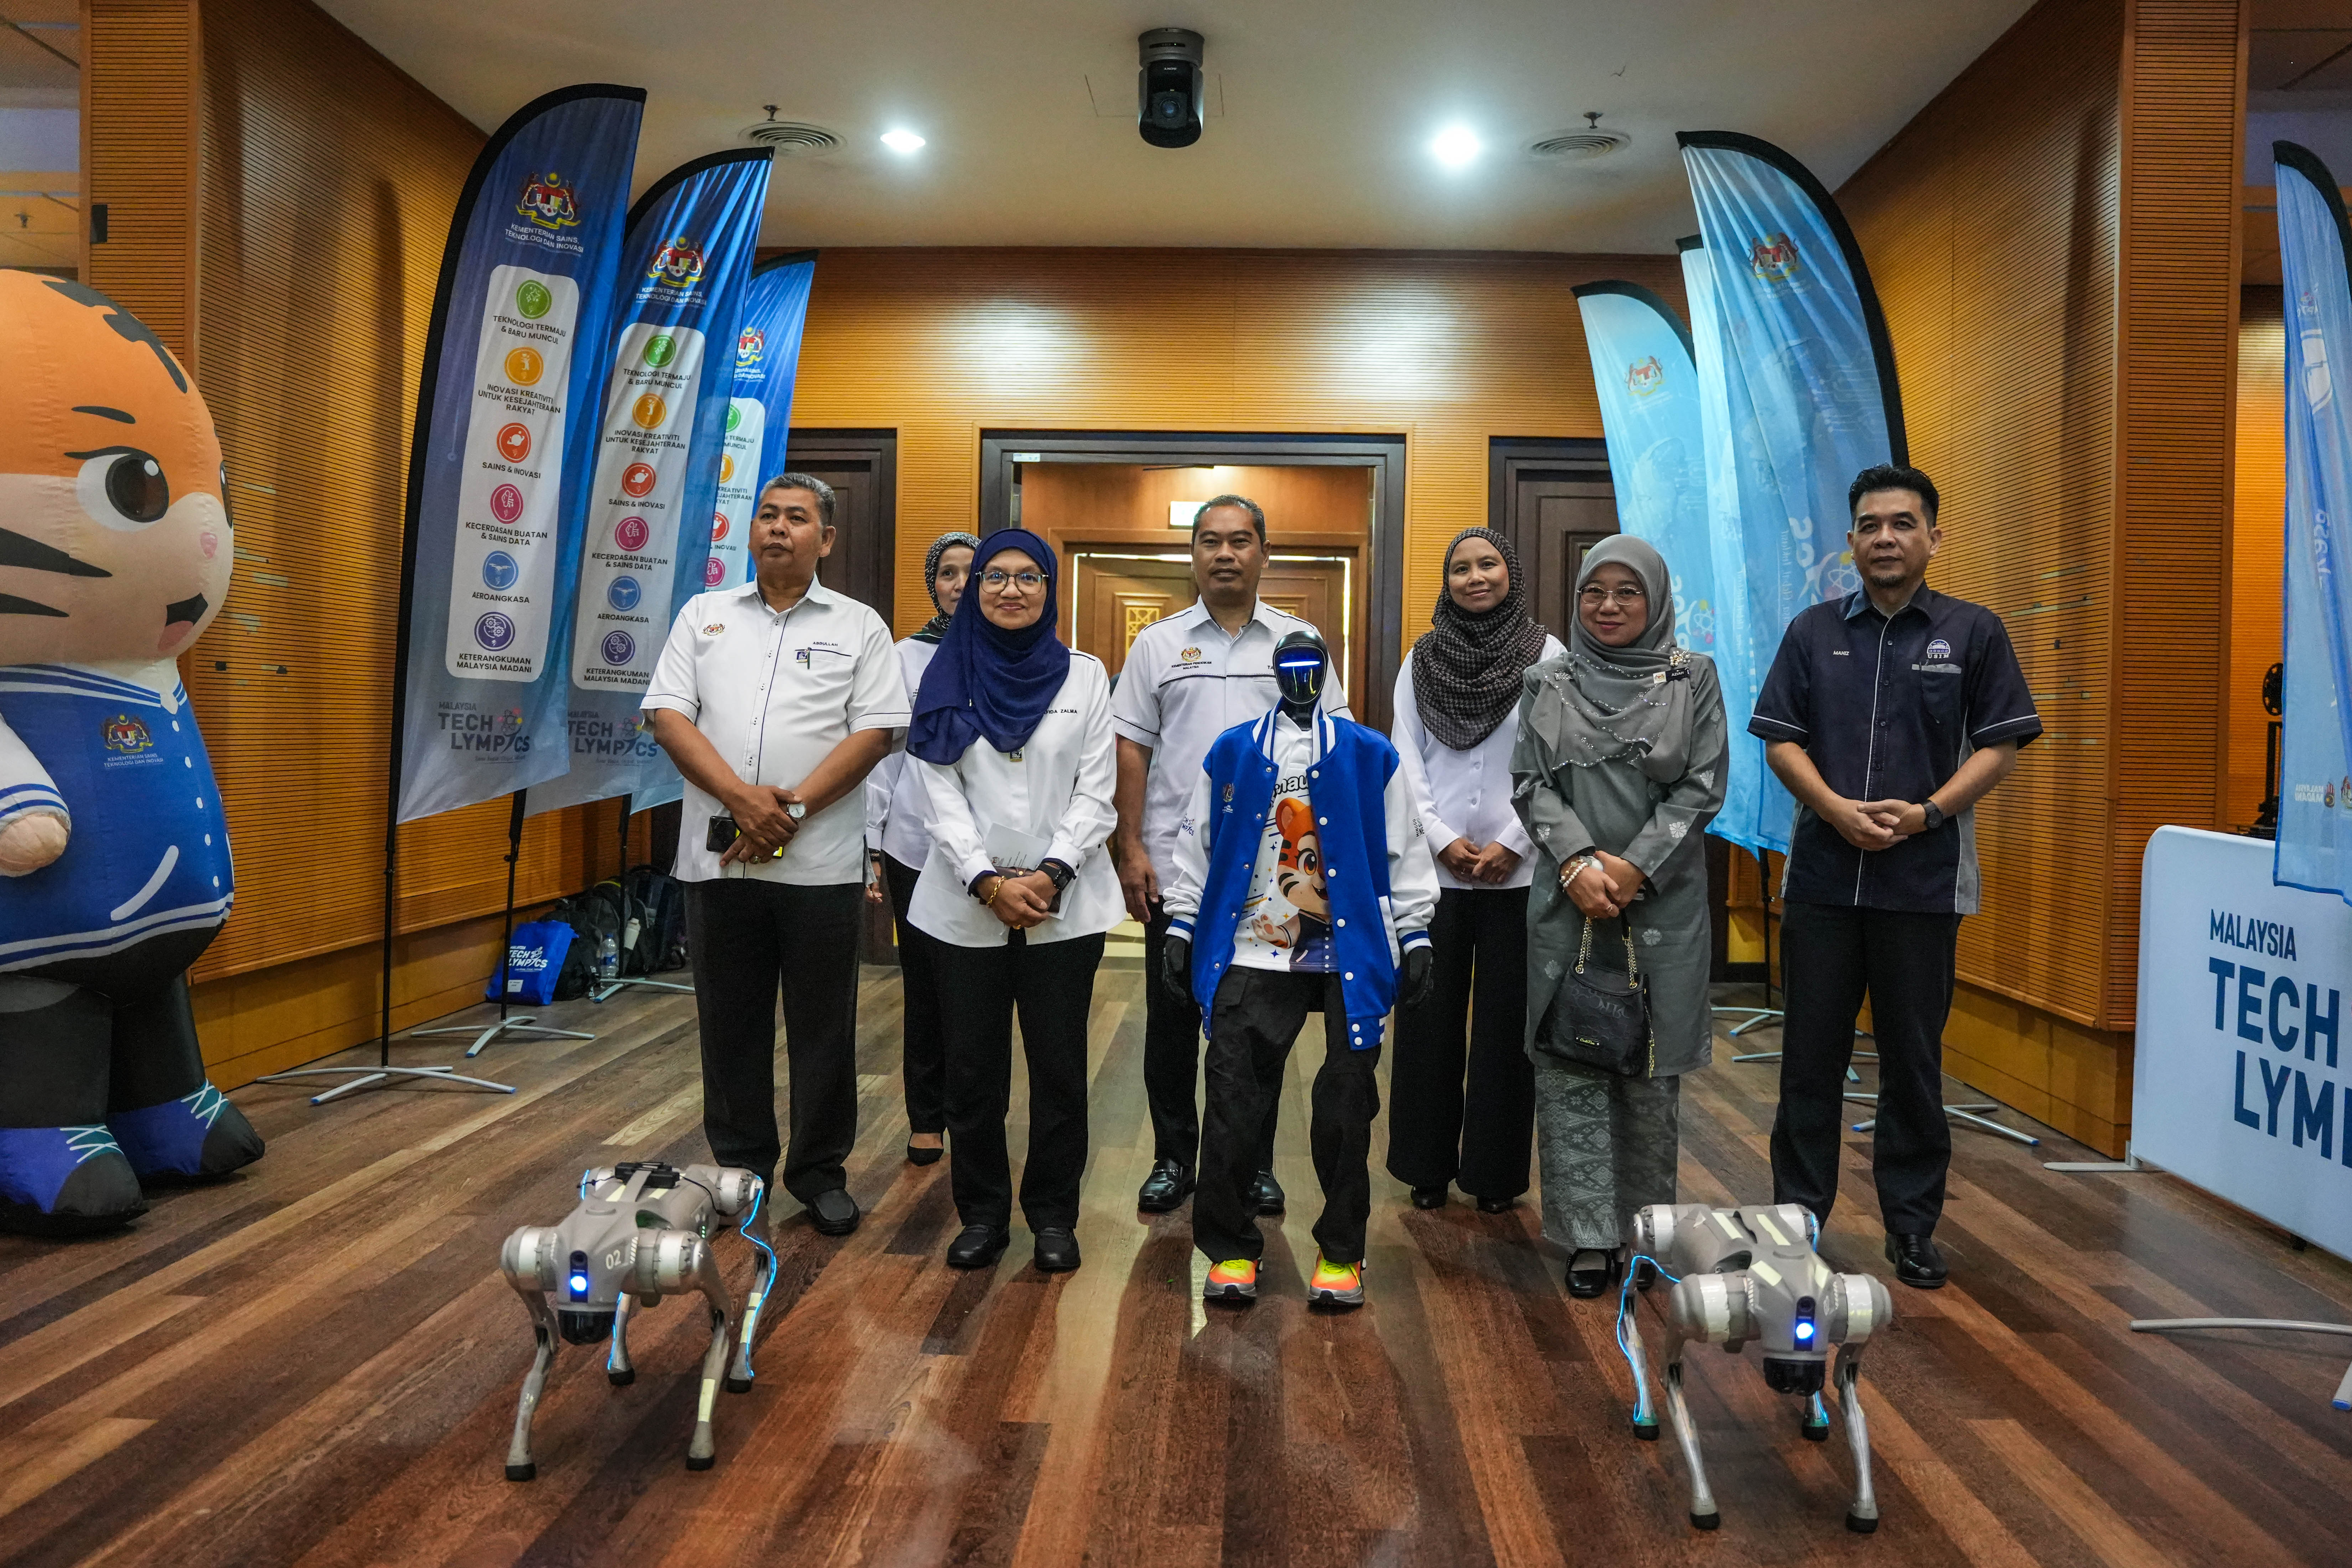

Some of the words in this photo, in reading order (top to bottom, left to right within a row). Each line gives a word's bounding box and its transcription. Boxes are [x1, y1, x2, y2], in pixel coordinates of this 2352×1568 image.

[511, 224, 554, 239] KEMENTERIAN
[505, 229, 543, 242] TEKNOLOGI
[543, 239, 555, 248] DAN
[556, 243, 584, 253] INOVASI
[636, 293, 670, 302] TEKNOLOGI
[642, 287, 683, 296] KEMENTERIAN
[493, 316, 533, 330] TEKNOLOGI
[535, 324, 566, 337] TERMAJU
[508, 328, 526, 338] BARU
[528, 333, 559, 344] MUNCUL
[623, 369, 659, 378] TEKNOLOGI
[661, 372, 690, 381] TERMAJU
[487, 384, 518, 395] INOVASI
[520, 390, 553, 404] KREATIVITI
[478, 390, 502, 401] UNTUK
[504, 395, 560, 414] KESEJAHTERAAN
[506, 404, 535, 415] RAKYAT
[631, 439, 685, 450] KESEJAHTERAAN
[482, 462, 506, 471] SAINS
[514, 467, 541, 478] INOVASI
[466, 522, 513, 536] KECERDASAN
[514, 530, 547, 538] BUATAN
[488, 534, 507, 543] SAINS
[509, 537, 530, 546] DATA
[592, 553, 638, 562] KECERDASAN
[472, 591, 529, 603] AEROANGKASA
[597, 614, 649, 623] AEROANGKASA
[459, 653, 531, 664] KETERANGKUMAN
[456, 662, 497, 671] MALAYSIA
[499, 664, 532, 673] MADANI
[586, 668, 649, 678] KETERANGKUMAN
[439, 702, 477, 711] MALAYSIA
[438, 713, 493, 733] TECH
[568, 721, 613, 737] TECH
[2209, 909, 2297, 962] MALAYSIA
[2209, 956, 2340, 1070] TECH
[606, 1249, 621, 1270] 02
